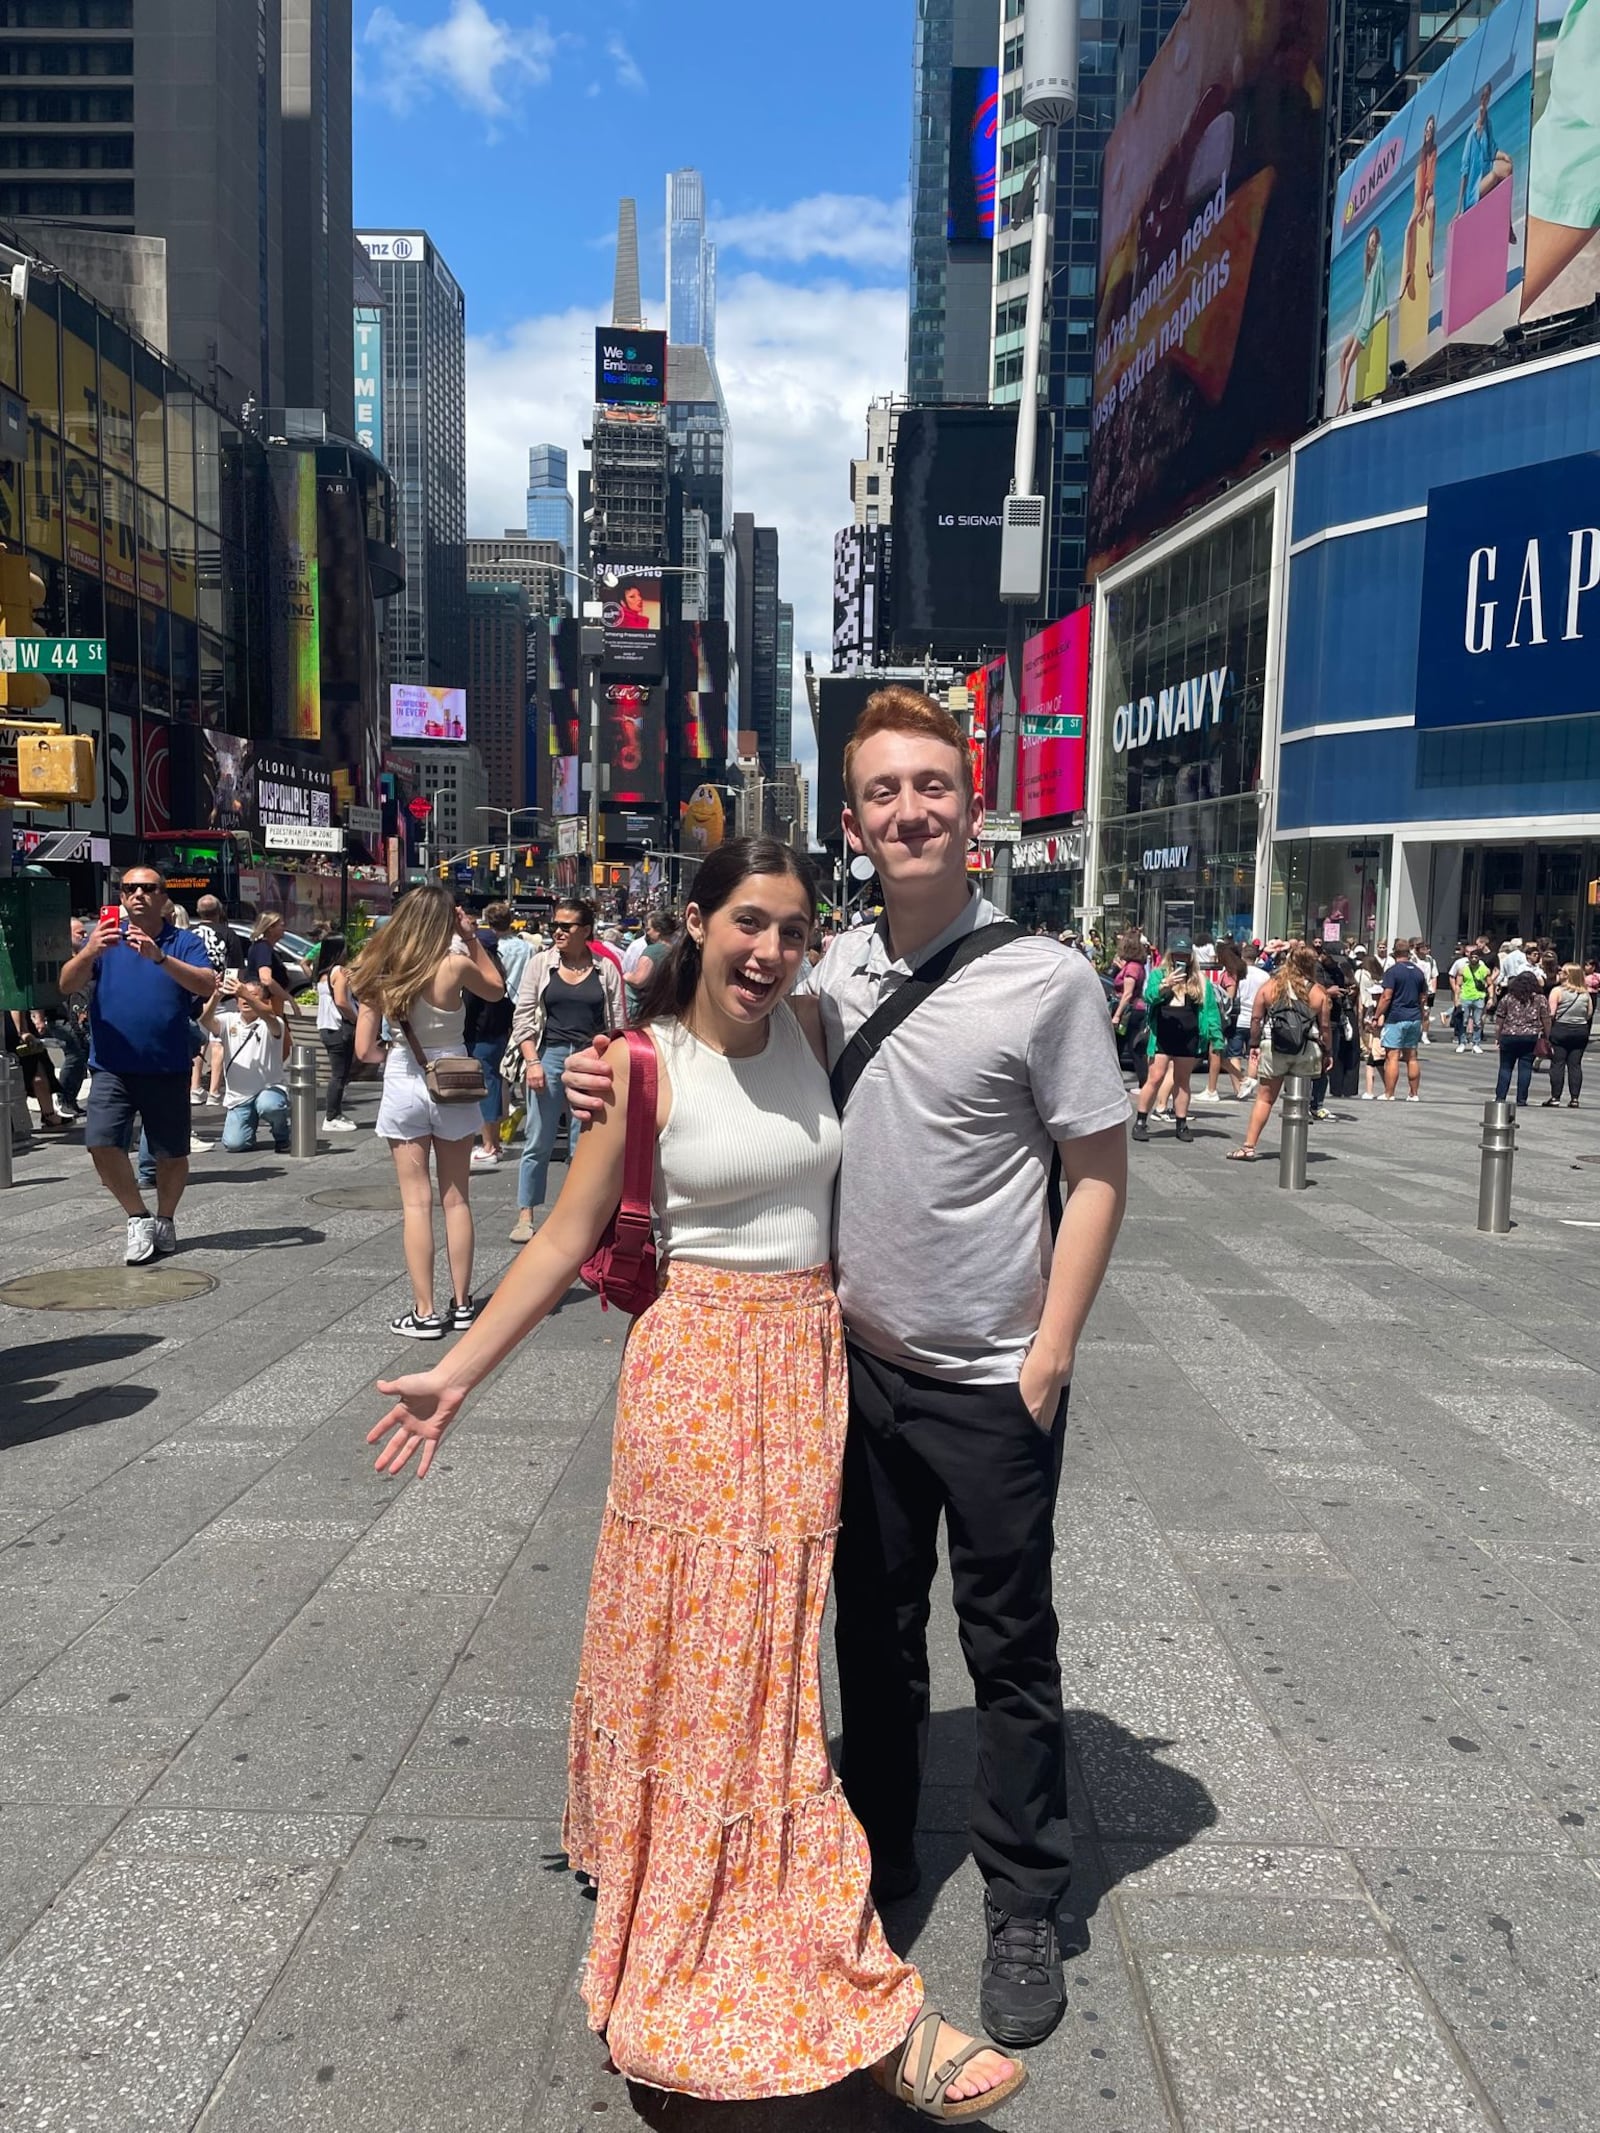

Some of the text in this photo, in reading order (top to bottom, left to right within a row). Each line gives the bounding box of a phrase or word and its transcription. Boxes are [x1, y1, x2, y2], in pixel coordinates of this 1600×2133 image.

[1368, 141, 1398, 195] NAVY
[1129, 248, 1177, 343] gonna
[1181, 167, 1227, 268] need
[1119, 337, 1156, 402] extra
[1160, 249, 1230, 358] napkins
[603, 346, 624, 359] We
[603, 359, 653, 373] Embrace
[354, 326, 376, 449] TIMES
[603, 372, 658, 386] Resilience
[938, 515, 1003, 526] LG SIGNAT
[596, 563, 663, 578] SAMSUNG
[1465, 527, 1600, 653] GAP
[21, 643, 102, 668] W 44 St
[397, 707, 428, 717] IN EVERY
[1112, 666, 1228, 753] OLD NAVY
[1027, 717, 1080, 735] W 44 ST
[257, 758, 331, 785] GLORIA TREVI
[258, 779, 310, 815] DISPONIBLE
[269, 828, 301, 837] PEDESTRIAN
[319, 831, 333, 839] ZONE
[312, 840, 333, 848] MOVING
[1143, 846, 1189, 870] OLD NAVY
